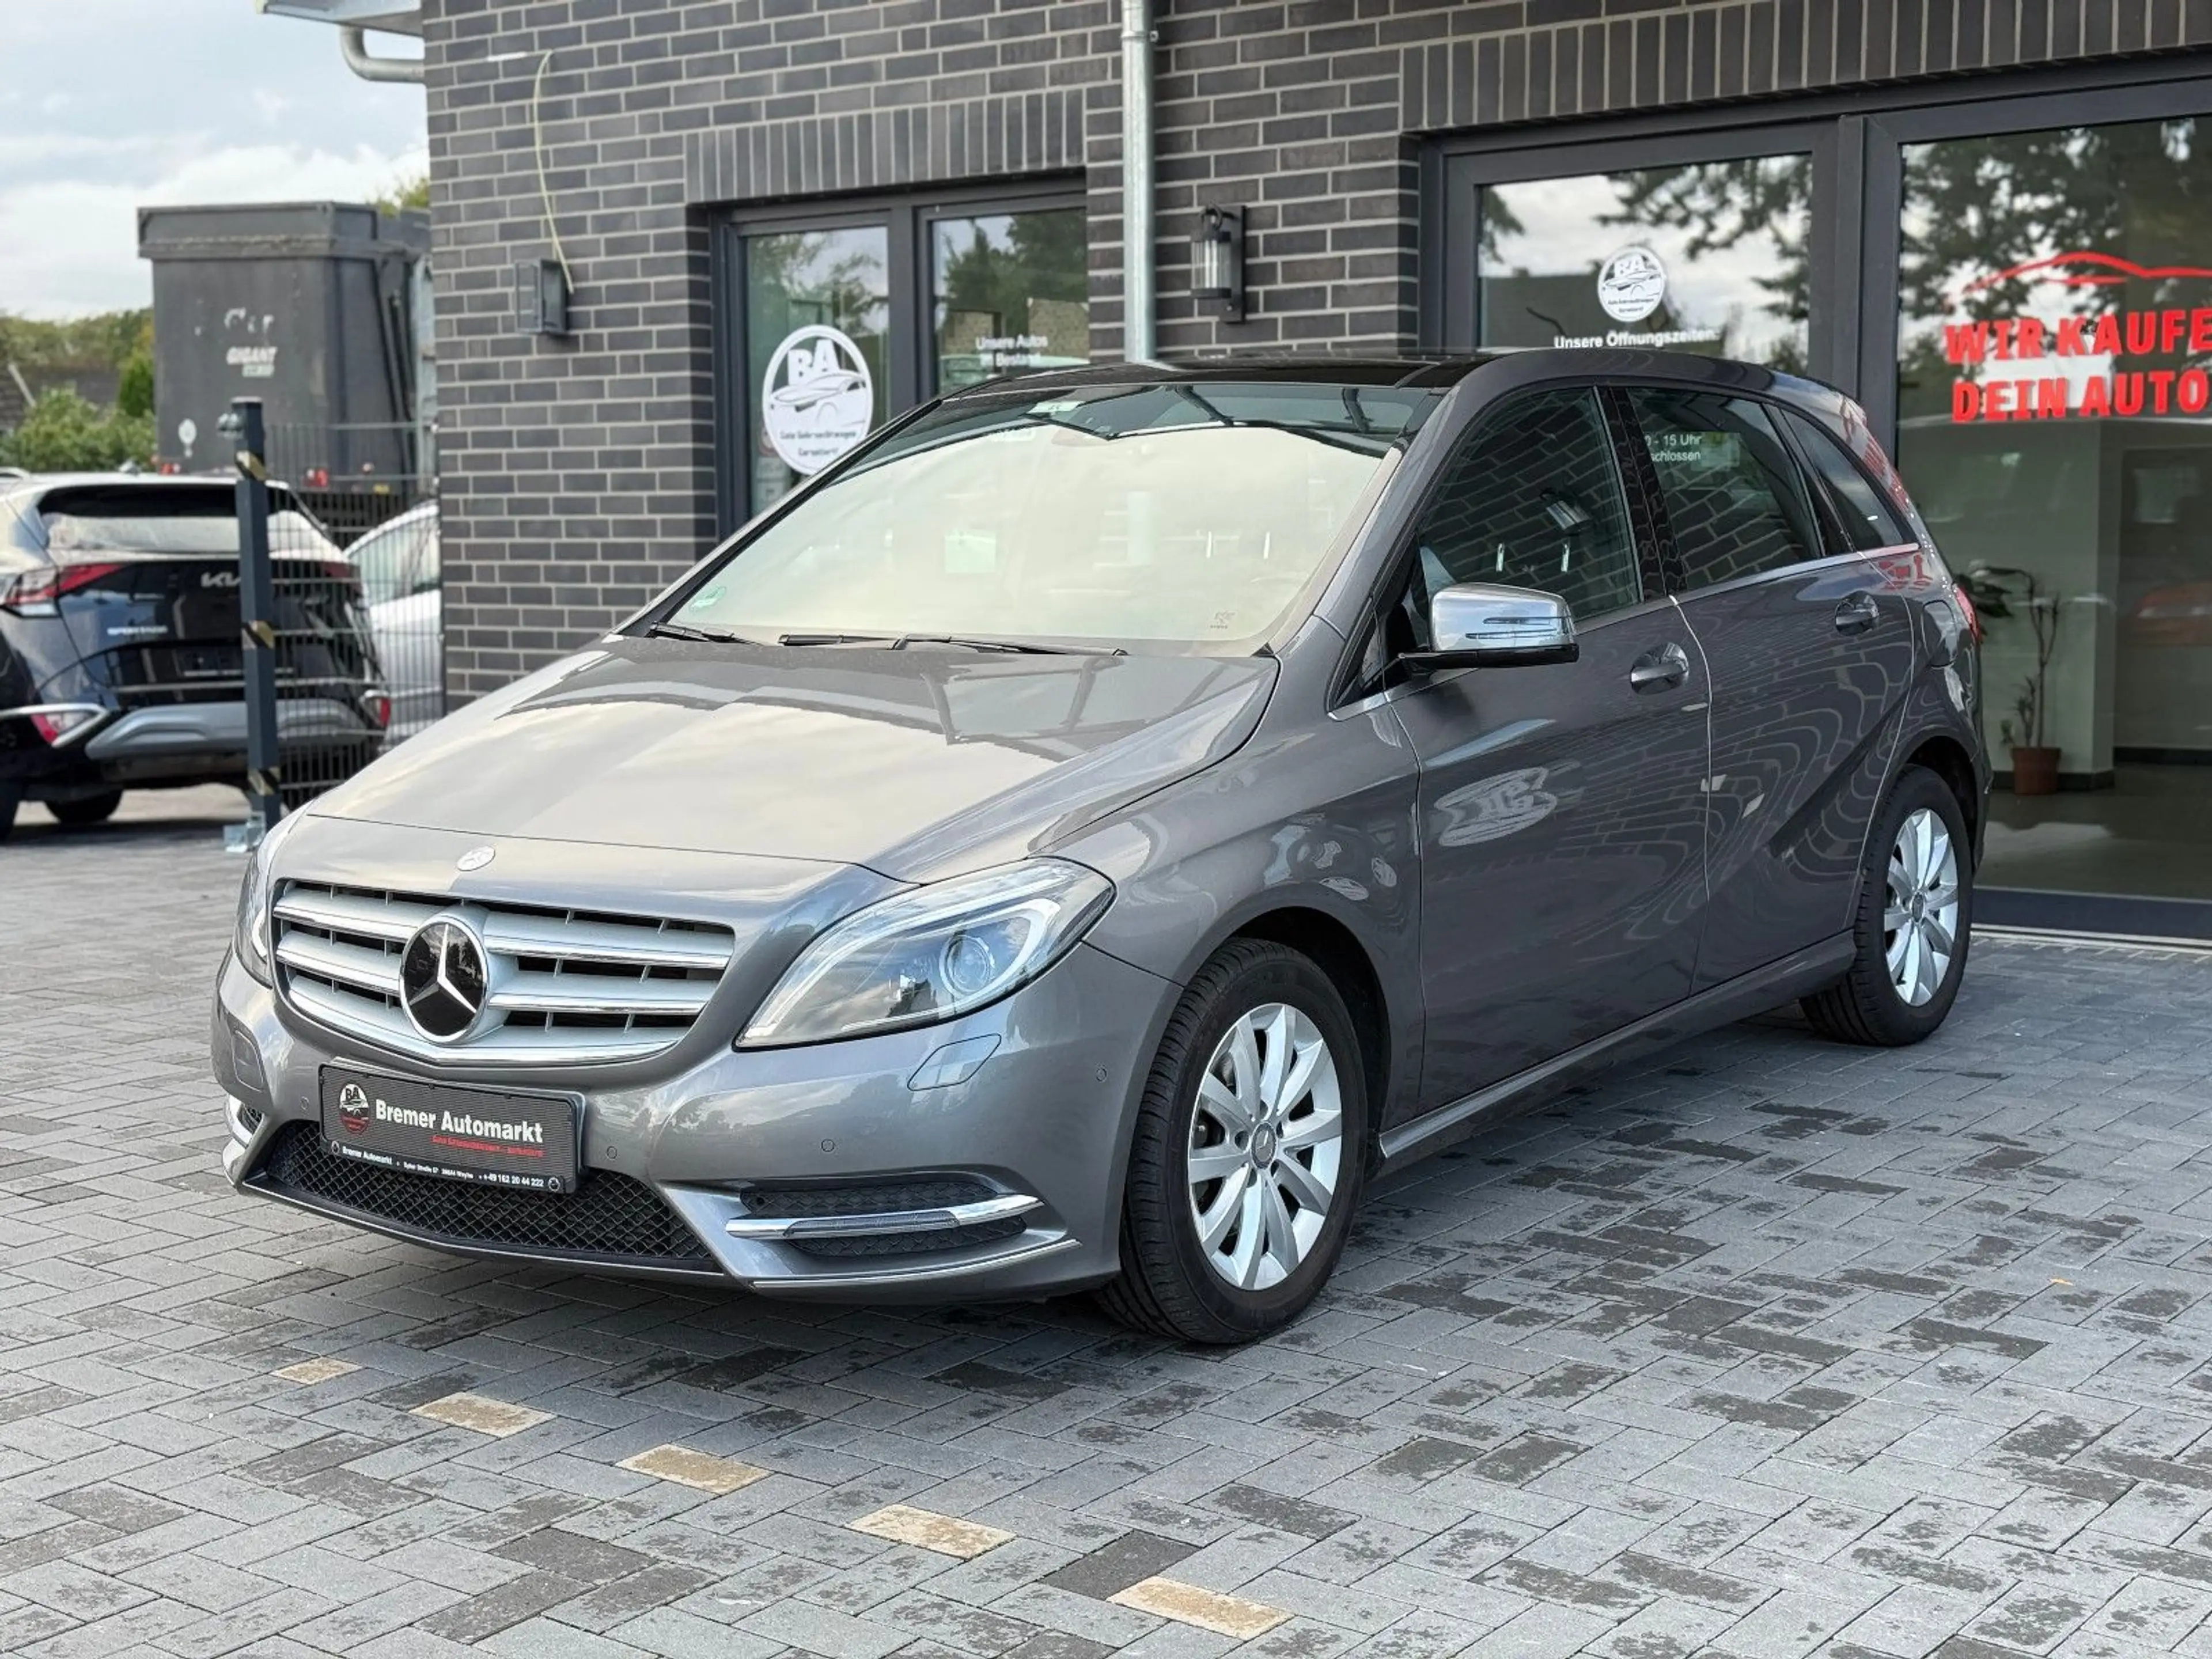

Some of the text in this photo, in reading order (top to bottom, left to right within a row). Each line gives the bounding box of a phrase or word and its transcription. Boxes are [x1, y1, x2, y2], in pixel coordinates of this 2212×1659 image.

[1554, 335, 1604, 349] Unsere
[1945, 309, 2212, 364] WIR KAUFE
[788, 339, 840, 385] BA
[1952, 367, 2208, 423] DEIN AUTO
[1664, 434, 1676, 446] 15
[1680, 433, 1702, 446] Uhr
[346, 1087, 360, 1101] BA
[376, 1099, 436, 1129] Bremer
[441, 1111, 543, 1143] Automarkt
